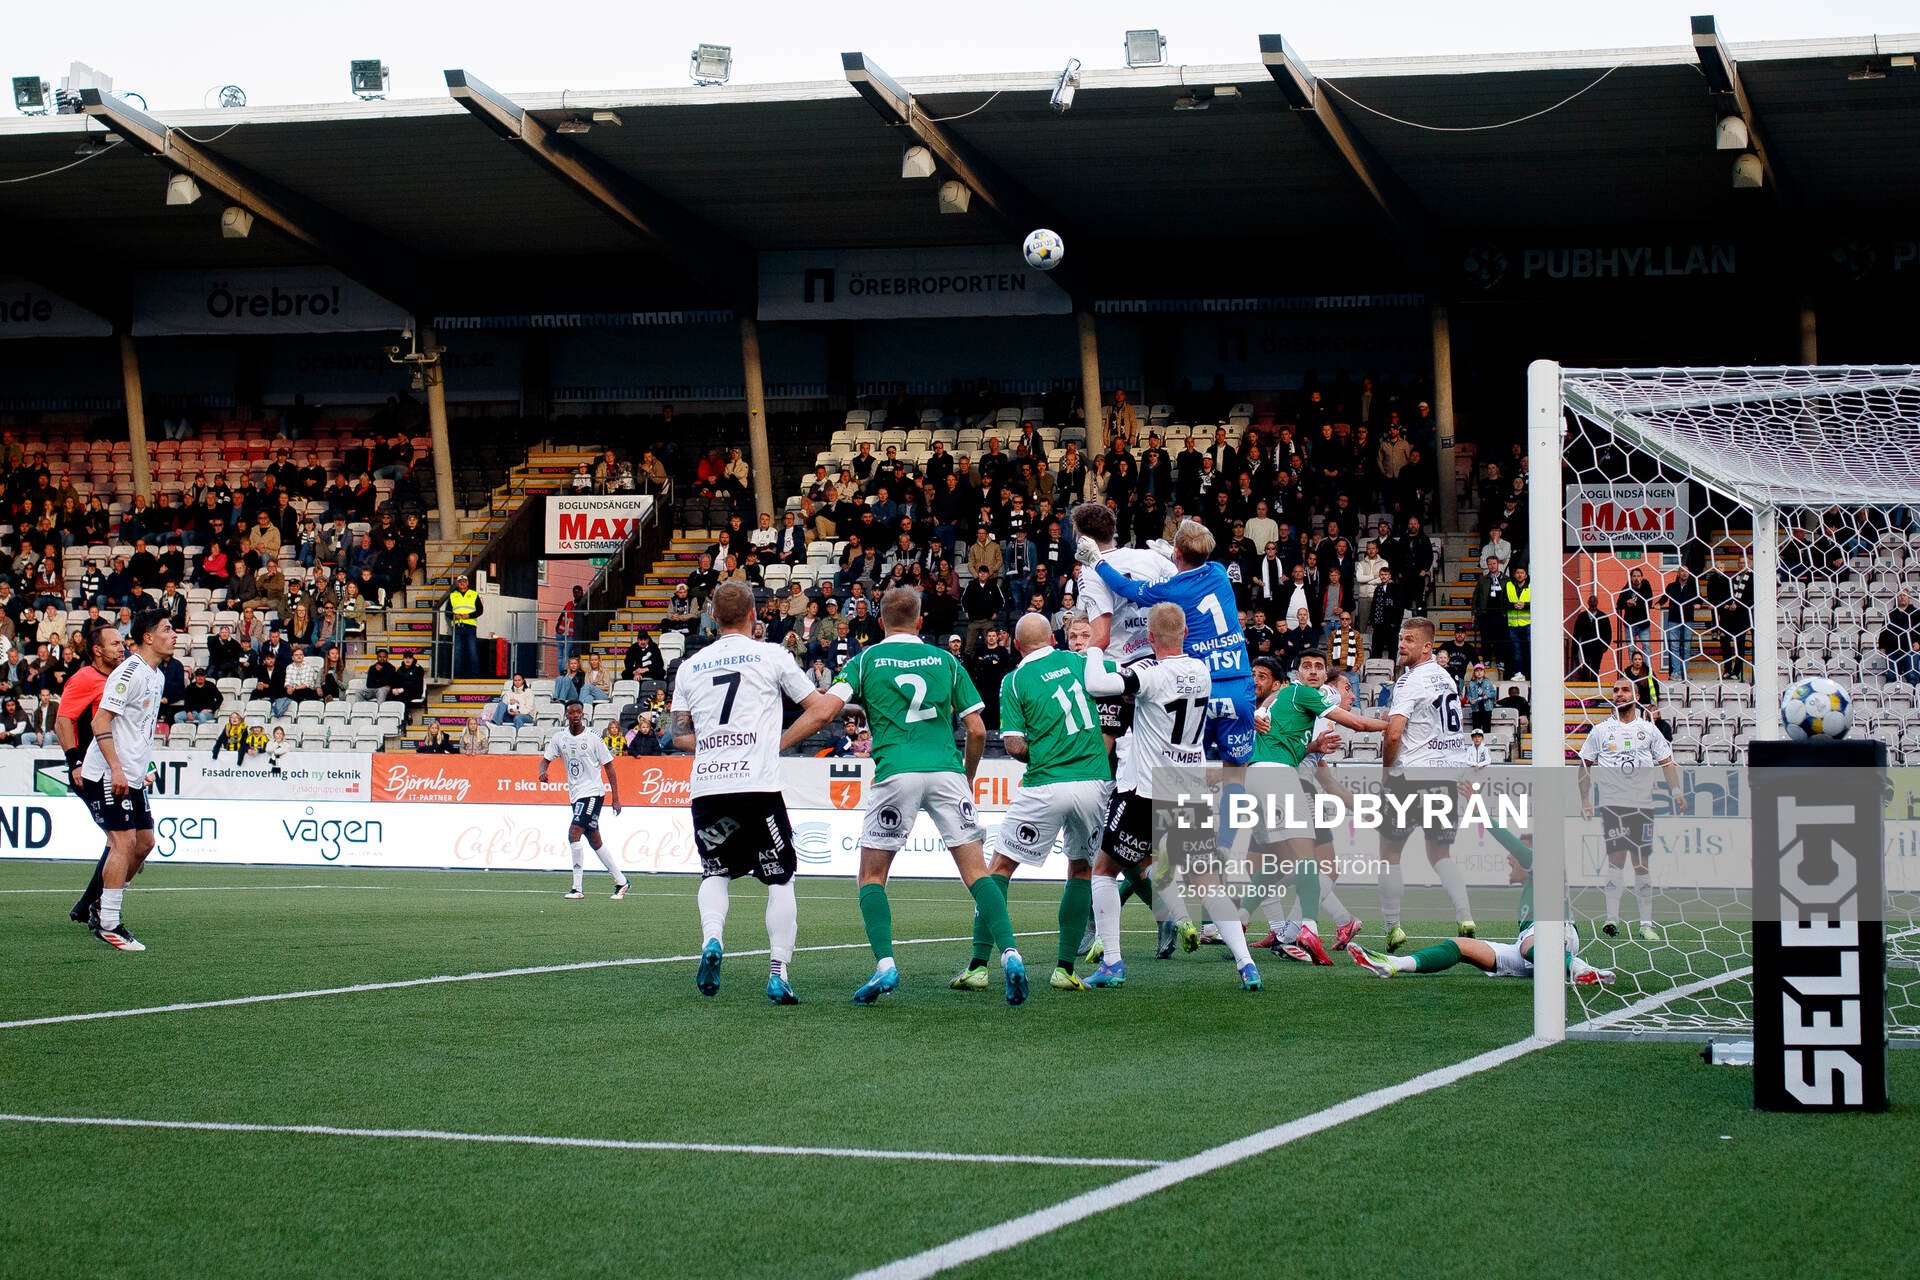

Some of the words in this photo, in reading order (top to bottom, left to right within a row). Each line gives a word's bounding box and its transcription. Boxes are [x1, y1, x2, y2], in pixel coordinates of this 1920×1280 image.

[1523, 244, 1737, 280] PUBHYLLAN
[848, 272, 1027, 296] ÖREBROPORTEN
[206, 282, 341, 319] Örebro!
[558, 500, 641, 510] BOGLUNDSÄNGEN
[1581, 502, 1675, 531] MAXI
[559, 541, 573, 550] ICA
[574, 541, 623, 550] STORMARK
[1196, 593, 1229, 636] 1
[692, 654, 761, 673] MALMBERGS
[874, 656, 942, 668] ZETTERSTRÖM
[712, 671, 741, 725] 7
[894, 673, 938, 723] 2
[1176, 685, 1202, 694] zero
[1051, 679, 1096, 735] 11
[1096, 703, 1122, 716] XACT
[1431, 693, 1461, 733] 16
[1164, 696, 1209, 745] 17
[698, 732, 757, 752] ANDERSSON
[291, 769, 309, 778] och
[312, 771, 325, 781] ny
[327, 769, 361, 779] teknik
[696, 772, 751, 781] FASTIGHETER
[697, 760, 750, 775] GÖRTZ
[384, 765, 472, 801] Björnberg
[496, 780, 511, 791] IT
[514, 779, 536, 791] ska
[638, 767, 692, 804] Björn
[408, 793, 453, 801] IT-PARTNER
[157, 817, 217, 857] gen
[282, 806, 383, 861] vågen
[758, 848, 779, 862] ACT
[1777, 796, 1863, 1106] SELECT
